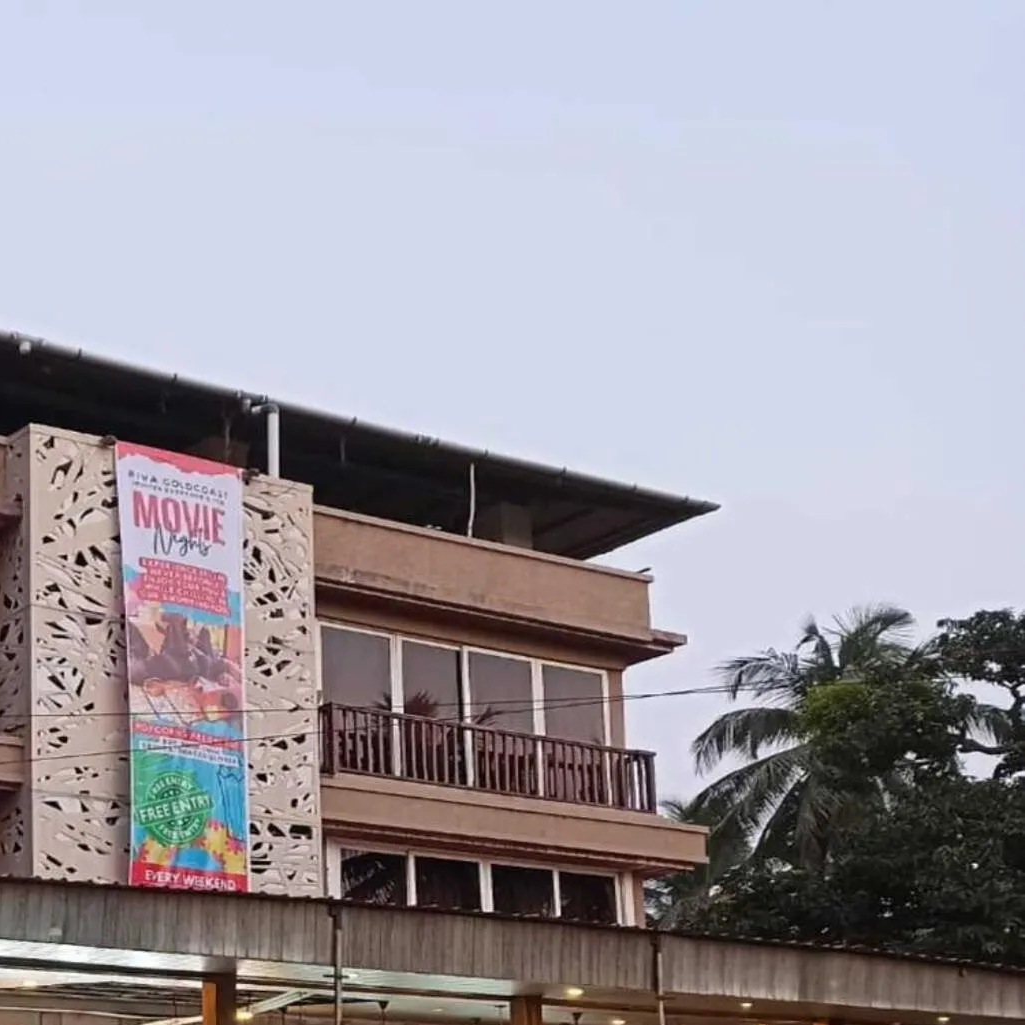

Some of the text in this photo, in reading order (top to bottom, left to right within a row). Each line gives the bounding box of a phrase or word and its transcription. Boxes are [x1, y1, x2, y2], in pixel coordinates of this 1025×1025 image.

[132, 489, 225, 546] MOVIE
[139, 795, 211, 823] FREE ENTRY
[144, 869, 237, 891] EVERY WEEKEND
